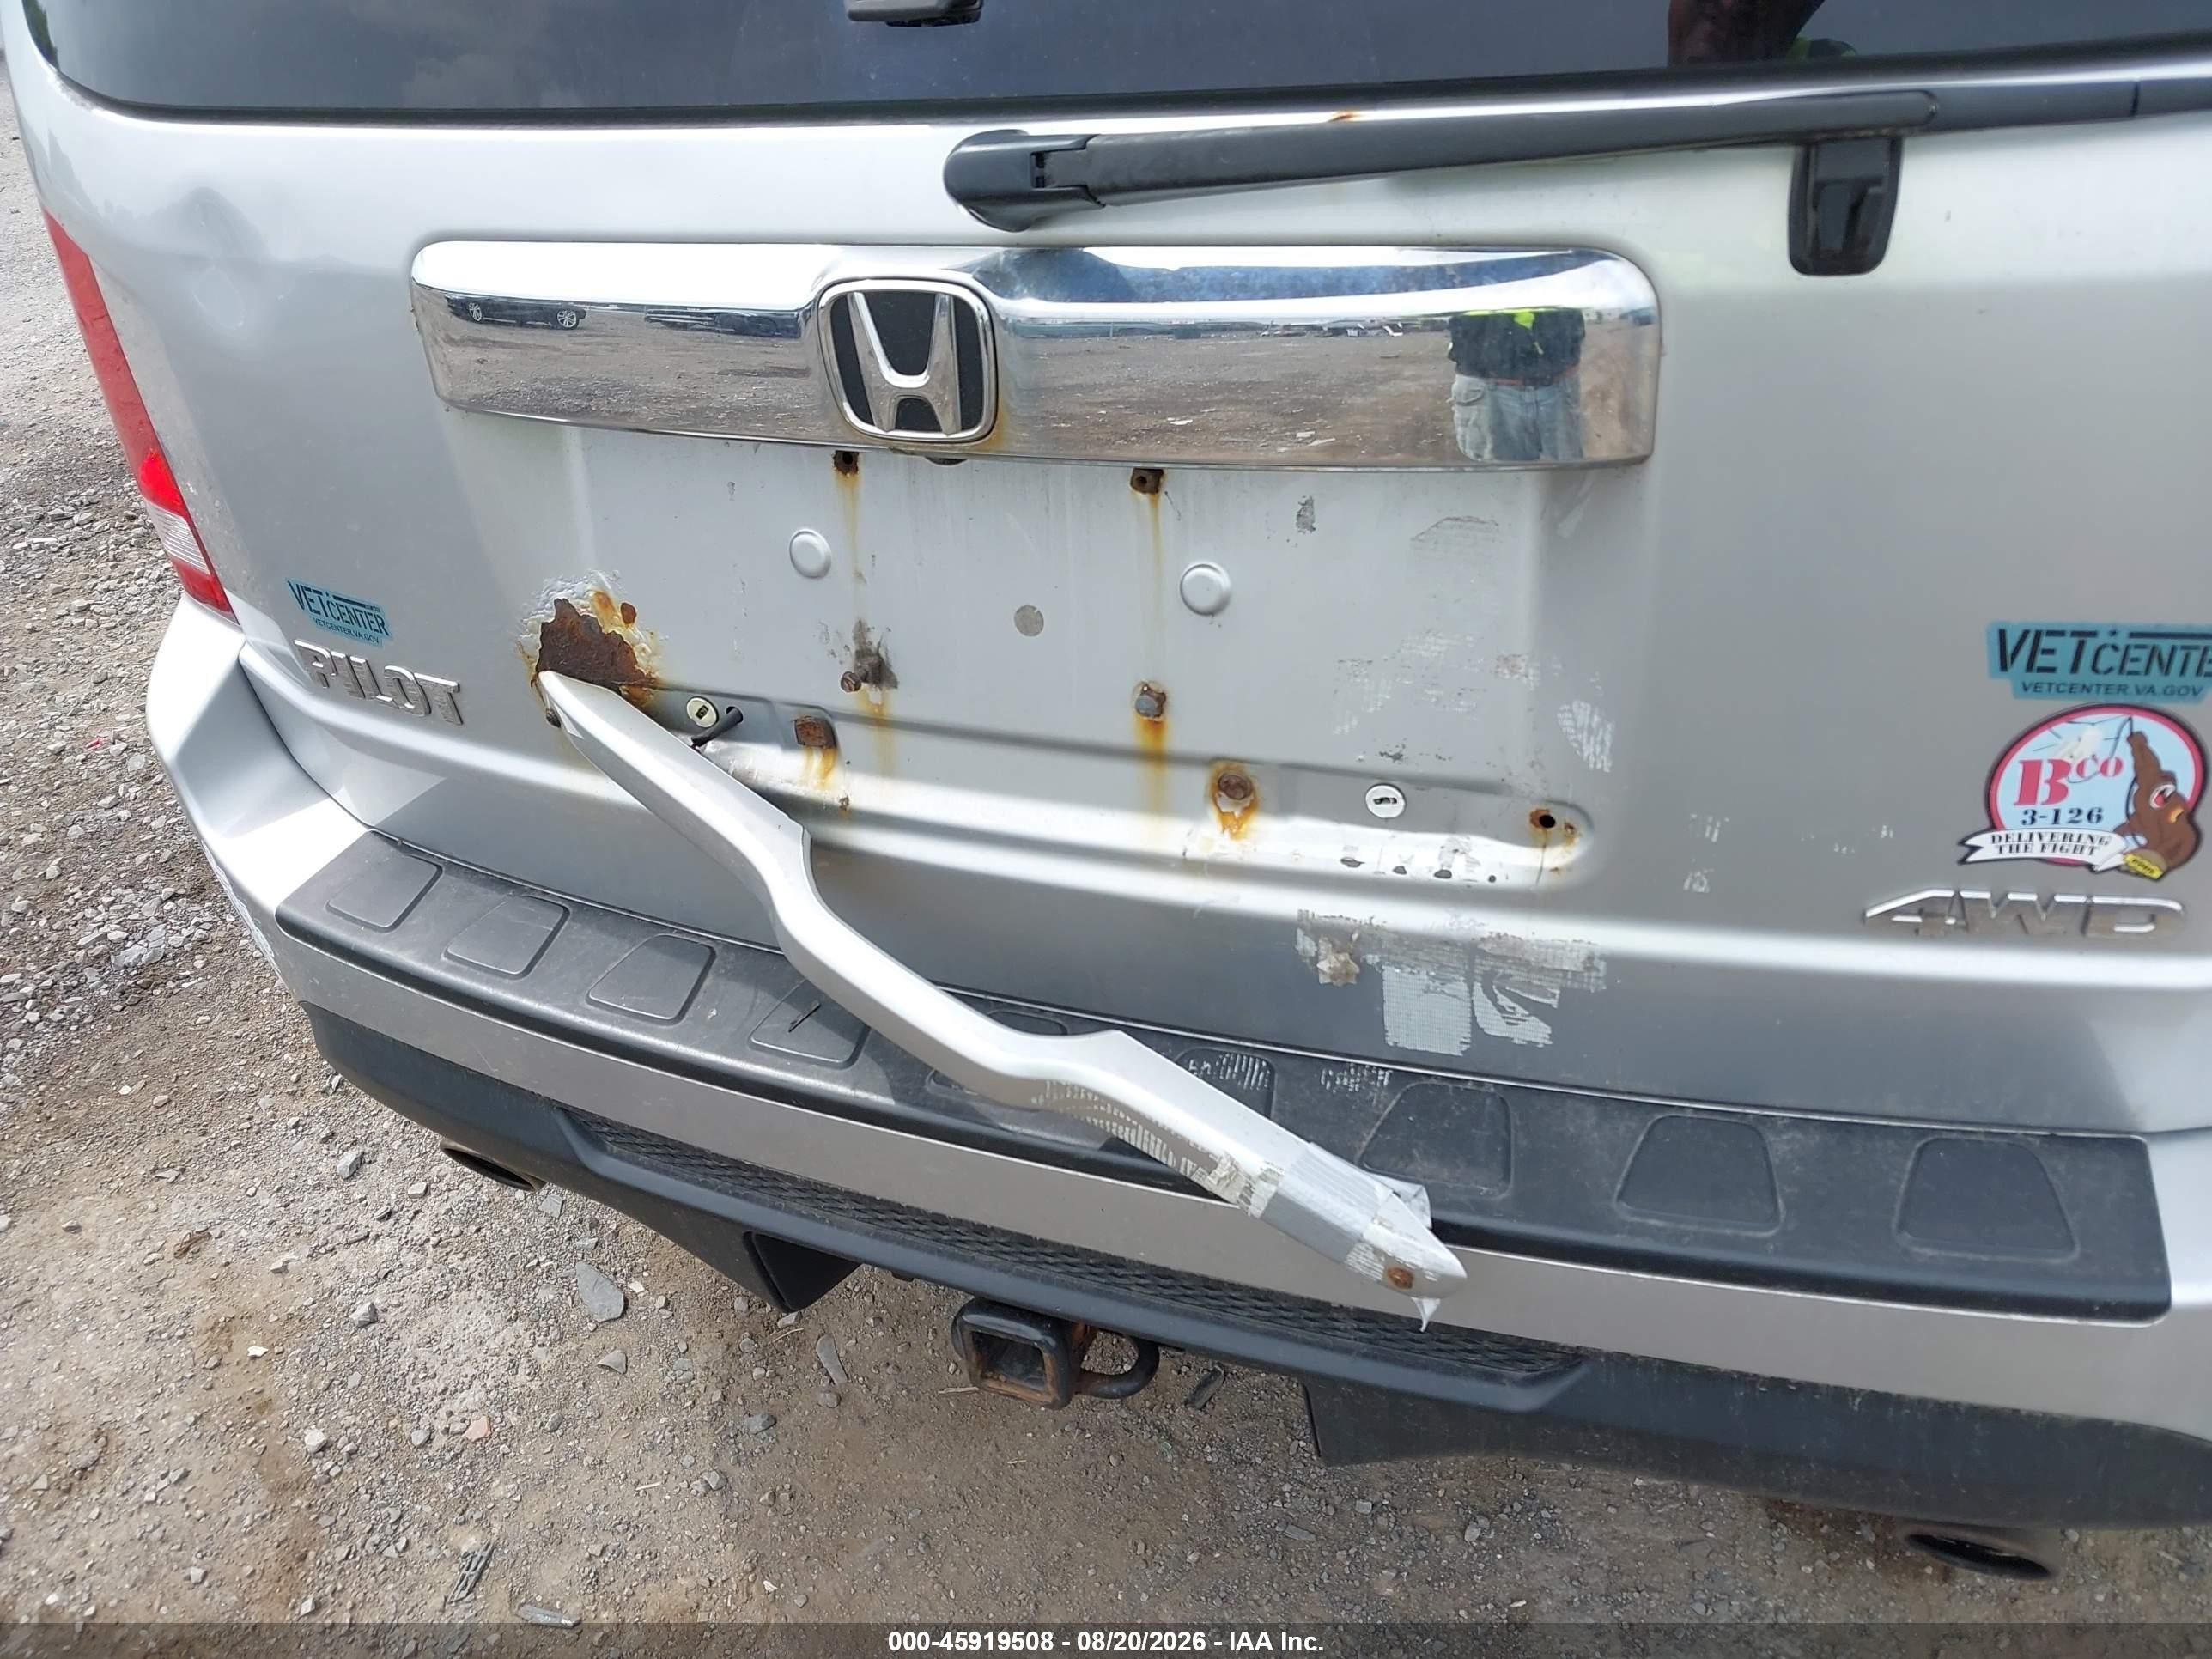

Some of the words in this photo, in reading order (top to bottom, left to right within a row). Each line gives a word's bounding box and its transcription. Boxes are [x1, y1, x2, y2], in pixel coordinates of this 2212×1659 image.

[294, 639, 464, 726] PILOT
[2021, 807, 2104, 825] 3-126
[1990, 831, 2112, 846] DELIVERING
[1995, 843, 2034, 854] THE
[2039, 843, 2100, 856] FIGHT
[1864, 888, 2184, 936] 4WD
